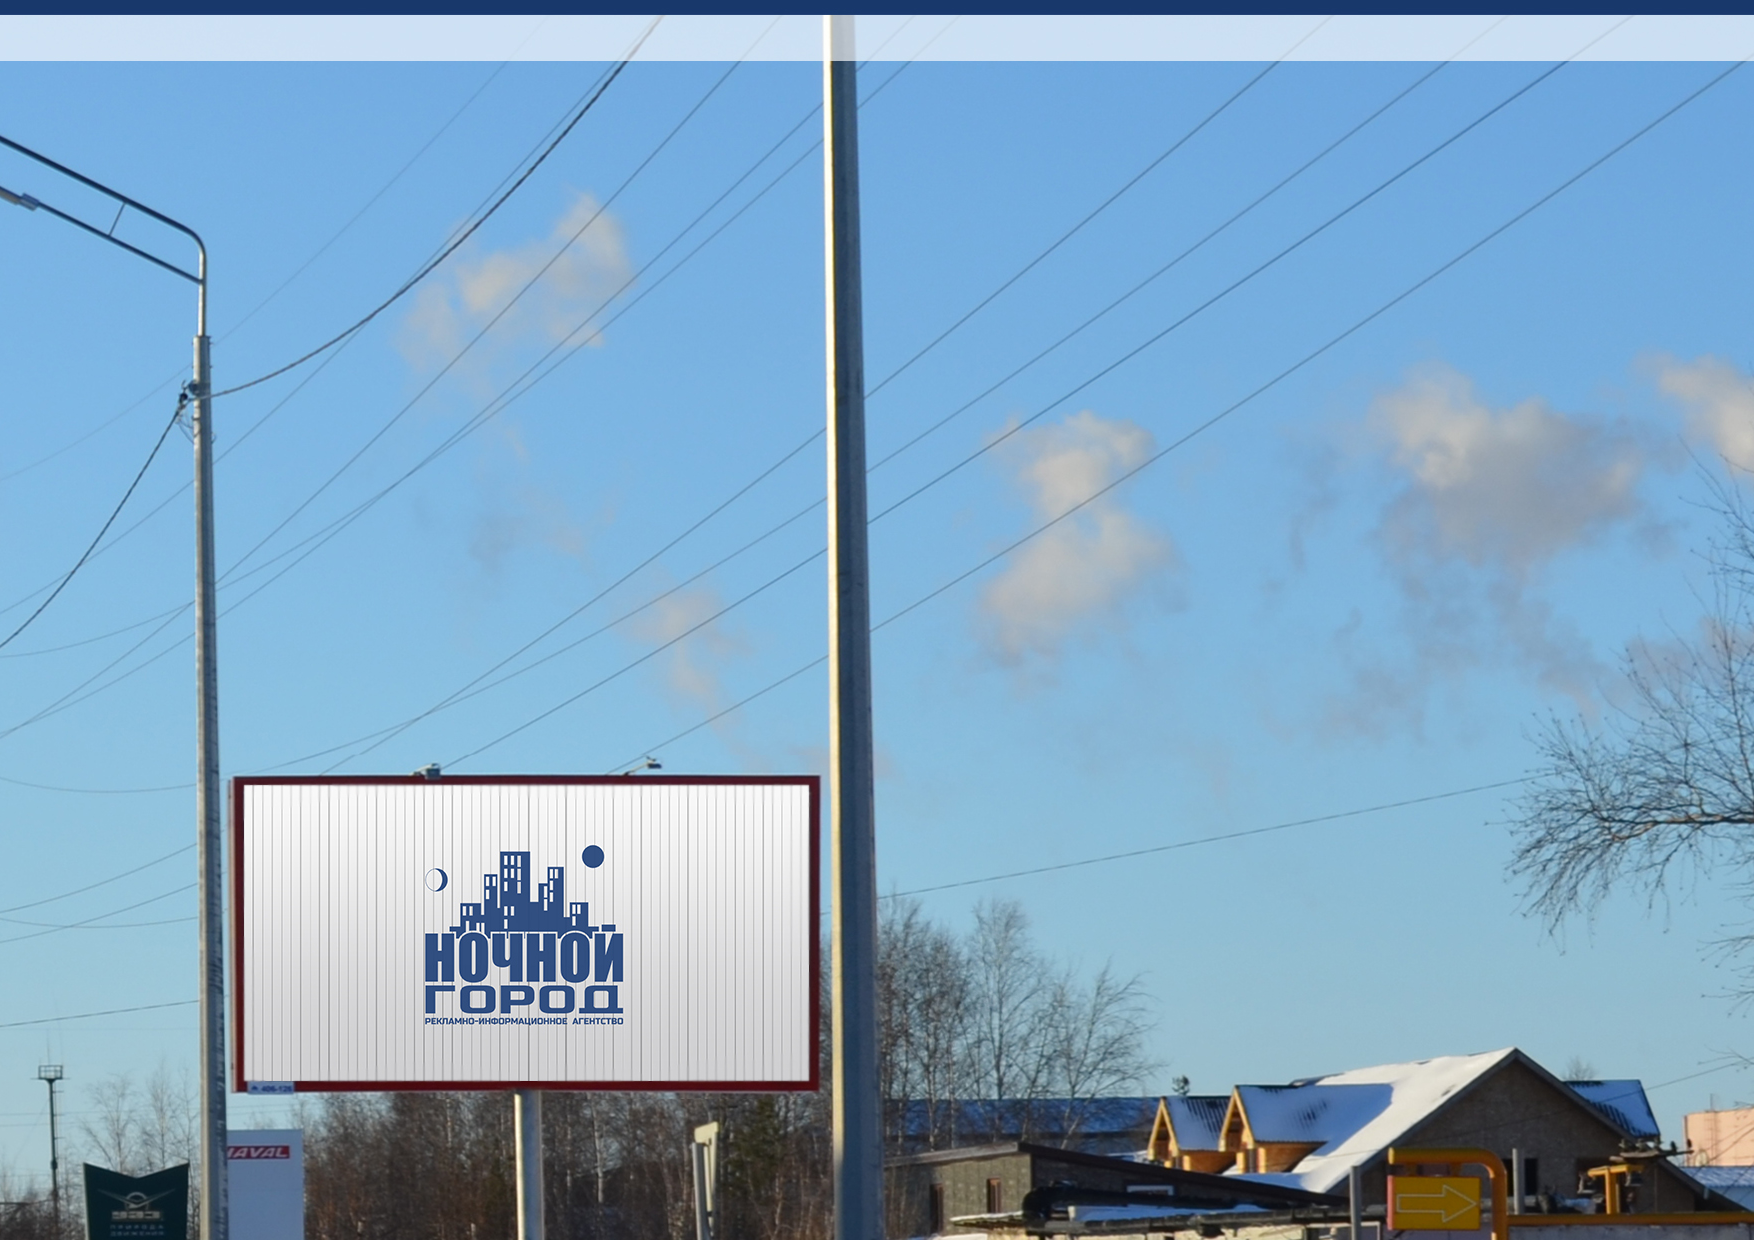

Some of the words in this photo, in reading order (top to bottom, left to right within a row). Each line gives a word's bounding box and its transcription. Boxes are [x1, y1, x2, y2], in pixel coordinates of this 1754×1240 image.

[425, 924, 623, 983] НОЧНОЙ
[425, 985, 623, 1013] ГОРОД
[424, 1017, 568, 1026] РЕКЛАМНО-ИНФОРМАЦИОННОЕ
[572, 1017, 624, 1025] АГЕНТСТВО
